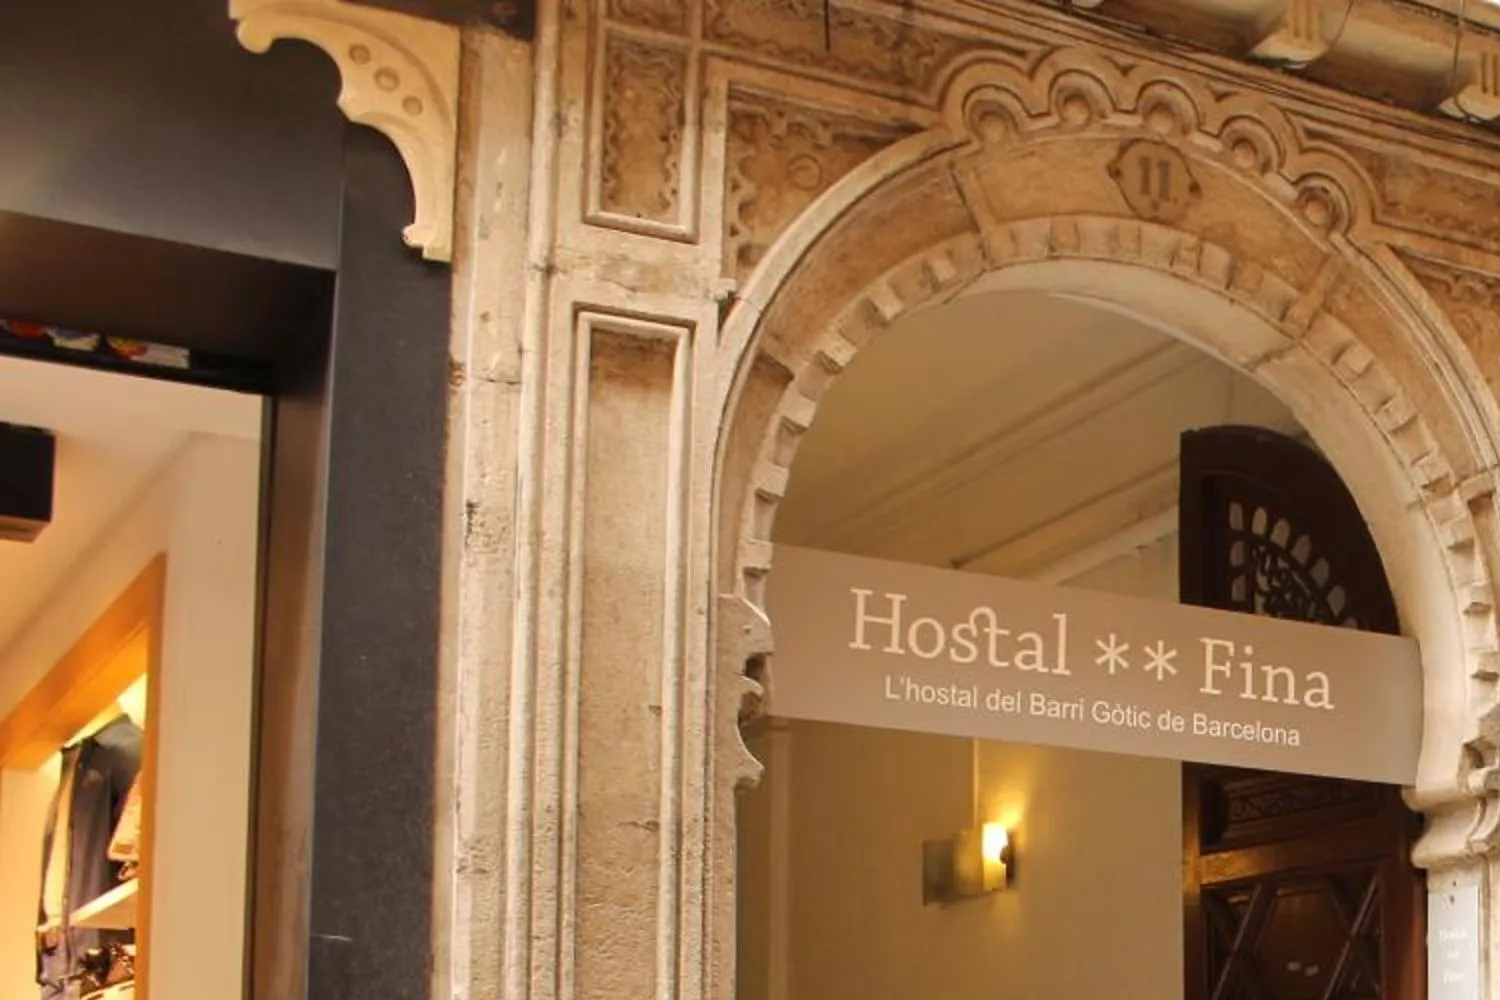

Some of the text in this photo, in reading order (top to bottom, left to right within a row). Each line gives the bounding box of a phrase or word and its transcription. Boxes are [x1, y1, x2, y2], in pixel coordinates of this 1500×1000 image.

[848, 587, 1335, 711] Hostal Fina
[883, 673, 1300, 747] L'hostal del Barri Gòtic de Barcelona
